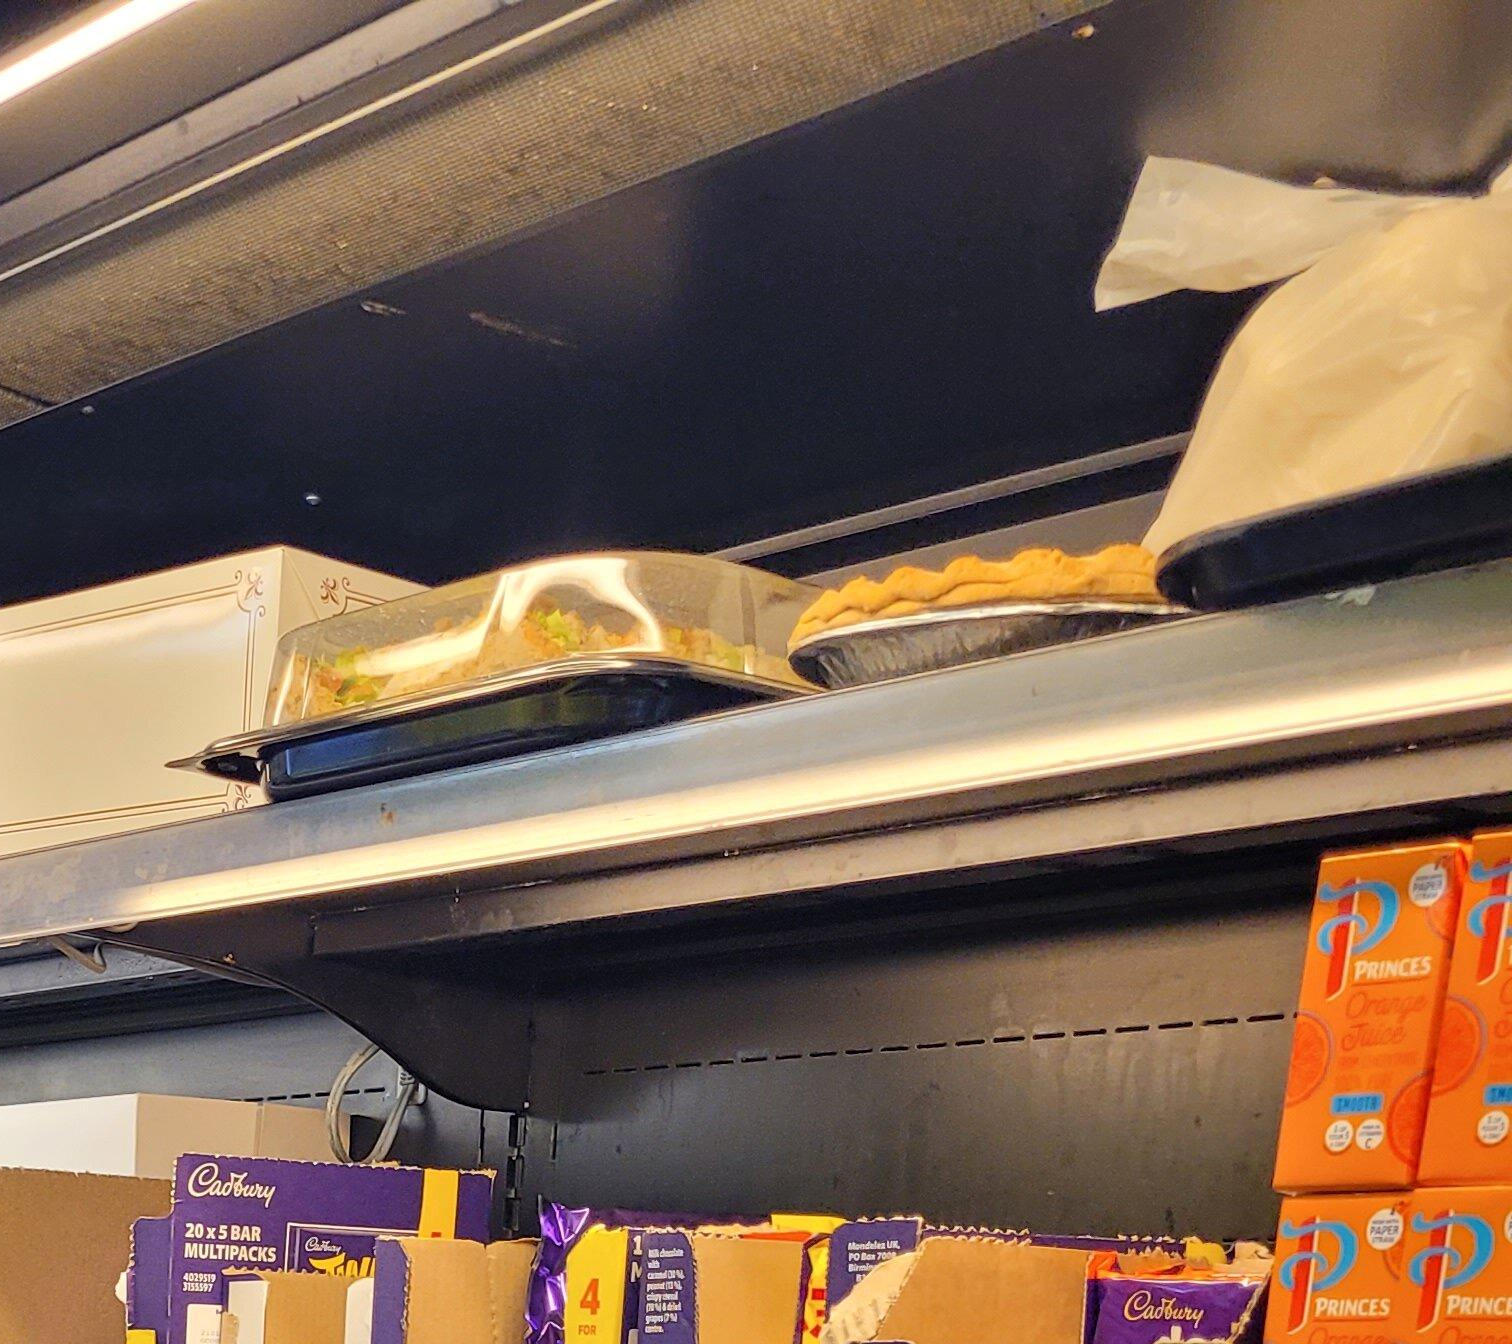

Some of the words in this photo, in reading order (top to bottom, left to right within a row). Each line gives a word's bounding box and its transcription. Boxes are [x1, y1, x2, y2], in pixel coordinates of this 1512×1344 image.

[1353, 956, 1432, 981] PRINCES
[1345, 991, 1429, 1024] Orange
[1341, 1022, 1406, 1051] Juice
[188, 1162, 276, 1208] Cadbury
[185, 1223, 203, 1239] 20
[206, 1227, 216, 1240] x
[218, 1225, 228, 1241] 5
[230, 1225, 262, 1242] BAR
[305, 1236, 341, 1254] Cadbury
[184, 1243, 277, 1263] MULTIPACKS
[580, 1278, 600, 1316] 4
[1124, 1290, 1204, 1329] Cadbury
[1314, 1297, 1390, 1317] PRINCES
[579, 1325, 597, 1336] FOR
